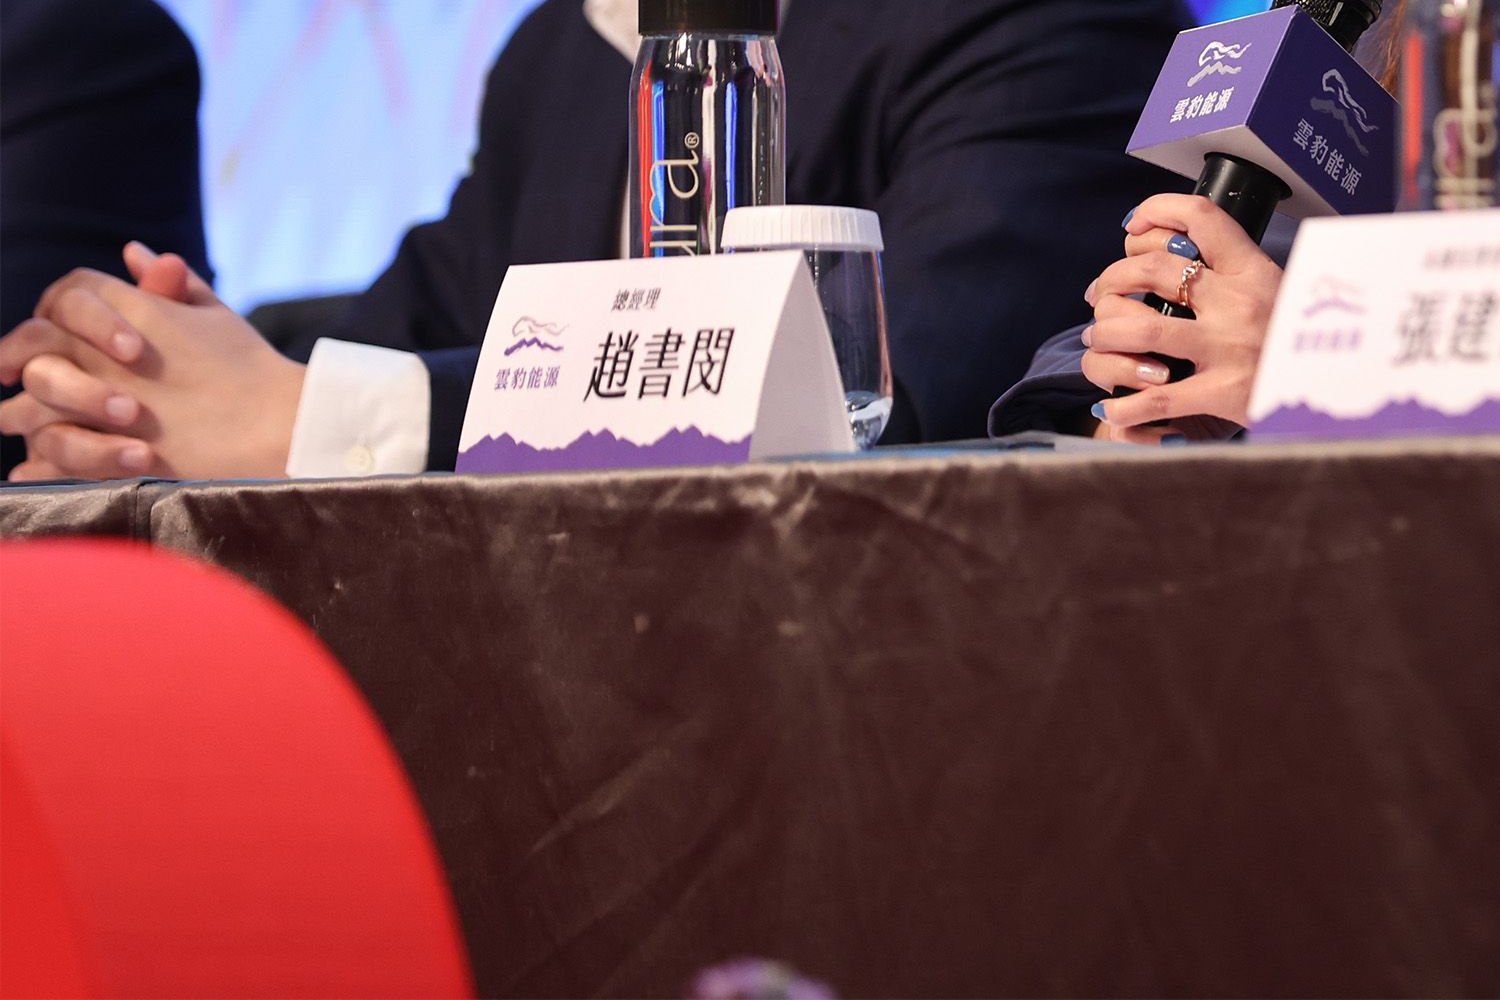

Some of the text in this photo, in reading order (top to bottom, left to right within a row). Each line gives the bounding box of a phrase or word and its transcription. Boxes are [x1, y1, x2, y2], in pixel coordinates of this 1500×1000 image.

[1169, 87, 1235, 123] 雲豹能源
[1292, 118, 1363, 196] 雲豹能源
[611, 287, 662, 311] 總經理
[493, 366, 561, 391] 雲豹能源
[583, 326, 736, 402] 趙書閔
